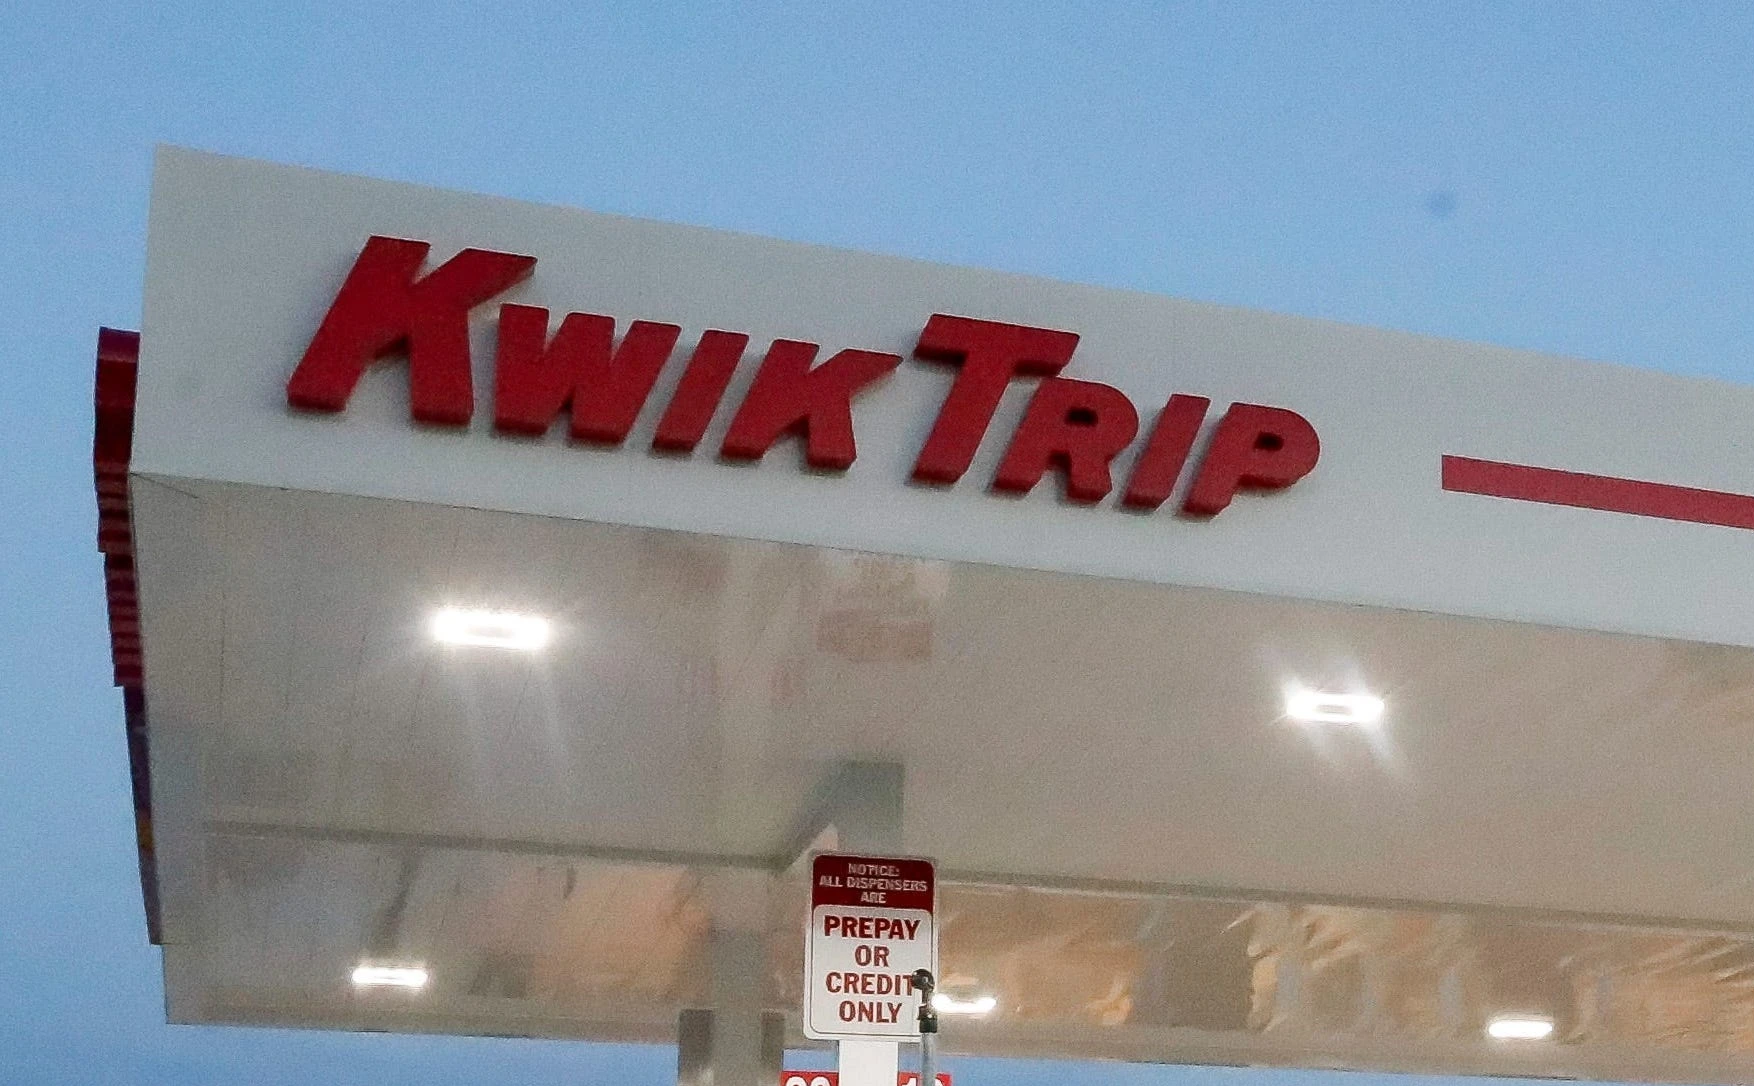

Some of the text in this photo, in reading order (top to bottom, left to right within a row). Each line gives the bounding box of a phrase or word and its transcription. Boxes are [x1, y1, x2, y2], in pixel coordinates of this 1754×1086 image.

[287, 234, 1320, 518] KWIK TRIP
[819, 875, 928, 892] ALL DISPENSERS
[860, 891, 887, 904] ARE
[823, 914, 921, 940] PREPAY
[854, 944, 890, 968] OR
[825, 971, 914, 997] CREDIT
[838, 1000, 903, 1024] ONLY
